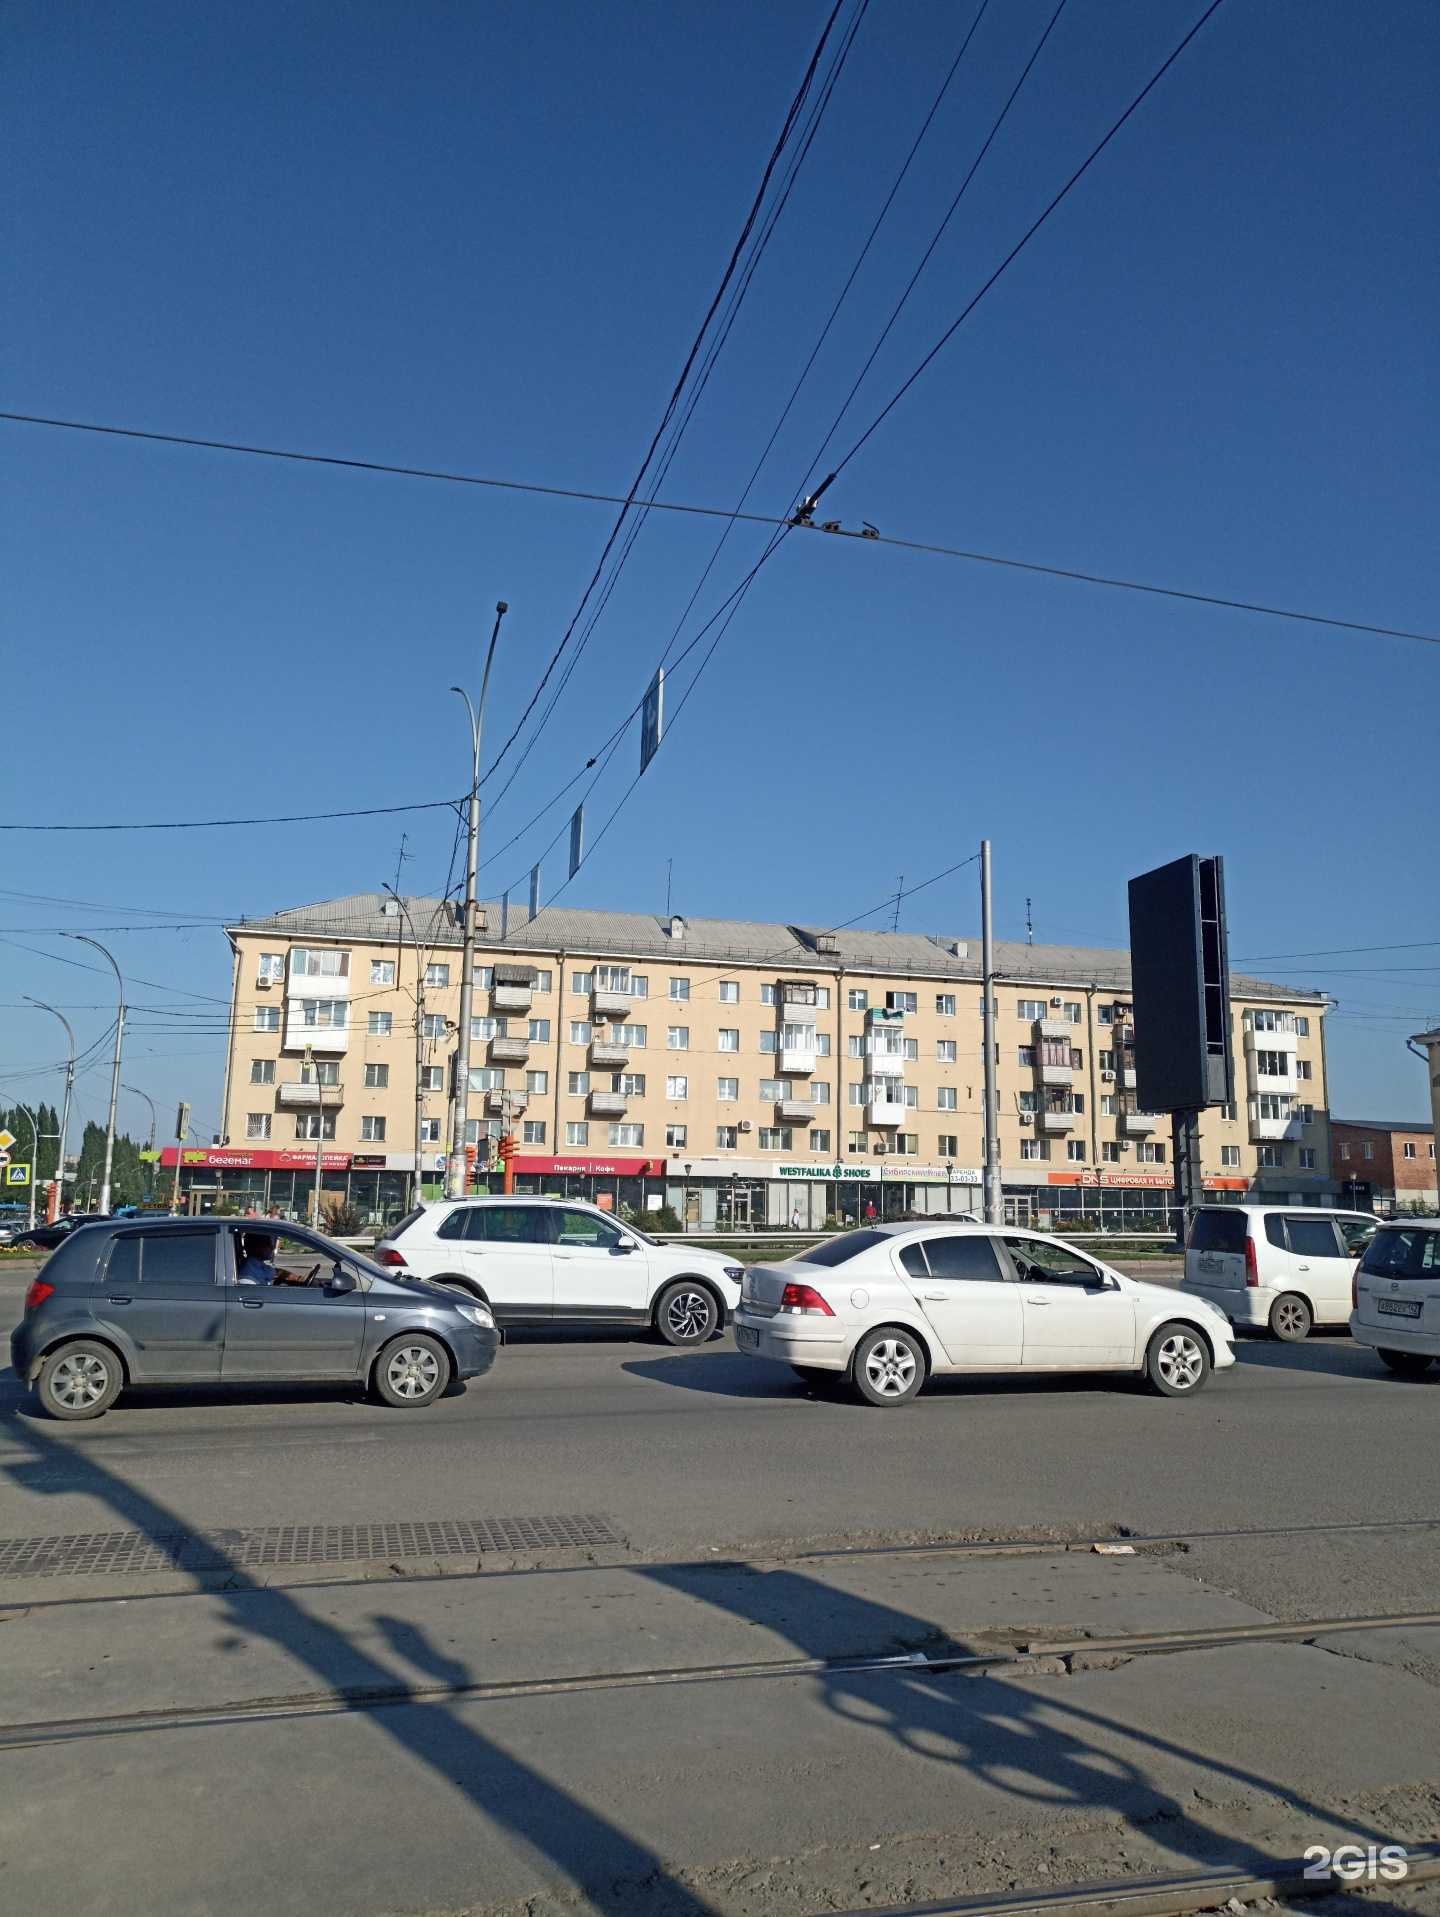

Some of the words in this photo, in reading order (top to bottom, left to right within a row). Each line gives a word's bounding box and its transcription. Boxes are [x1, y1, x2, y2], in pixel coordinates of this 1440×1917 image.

[553, 1164, 586, 1173] Пекарня
[595, 1165, 615, 1173] Кофе
[779, 1166, 831, 1177] WESTFALIKA
[843, 1168, 871, 1178] SHOES
[1082, 1174, 1109, 1184] DNS
[1110, 1176, 1147, 1185] ЦИФРОВАЯ
